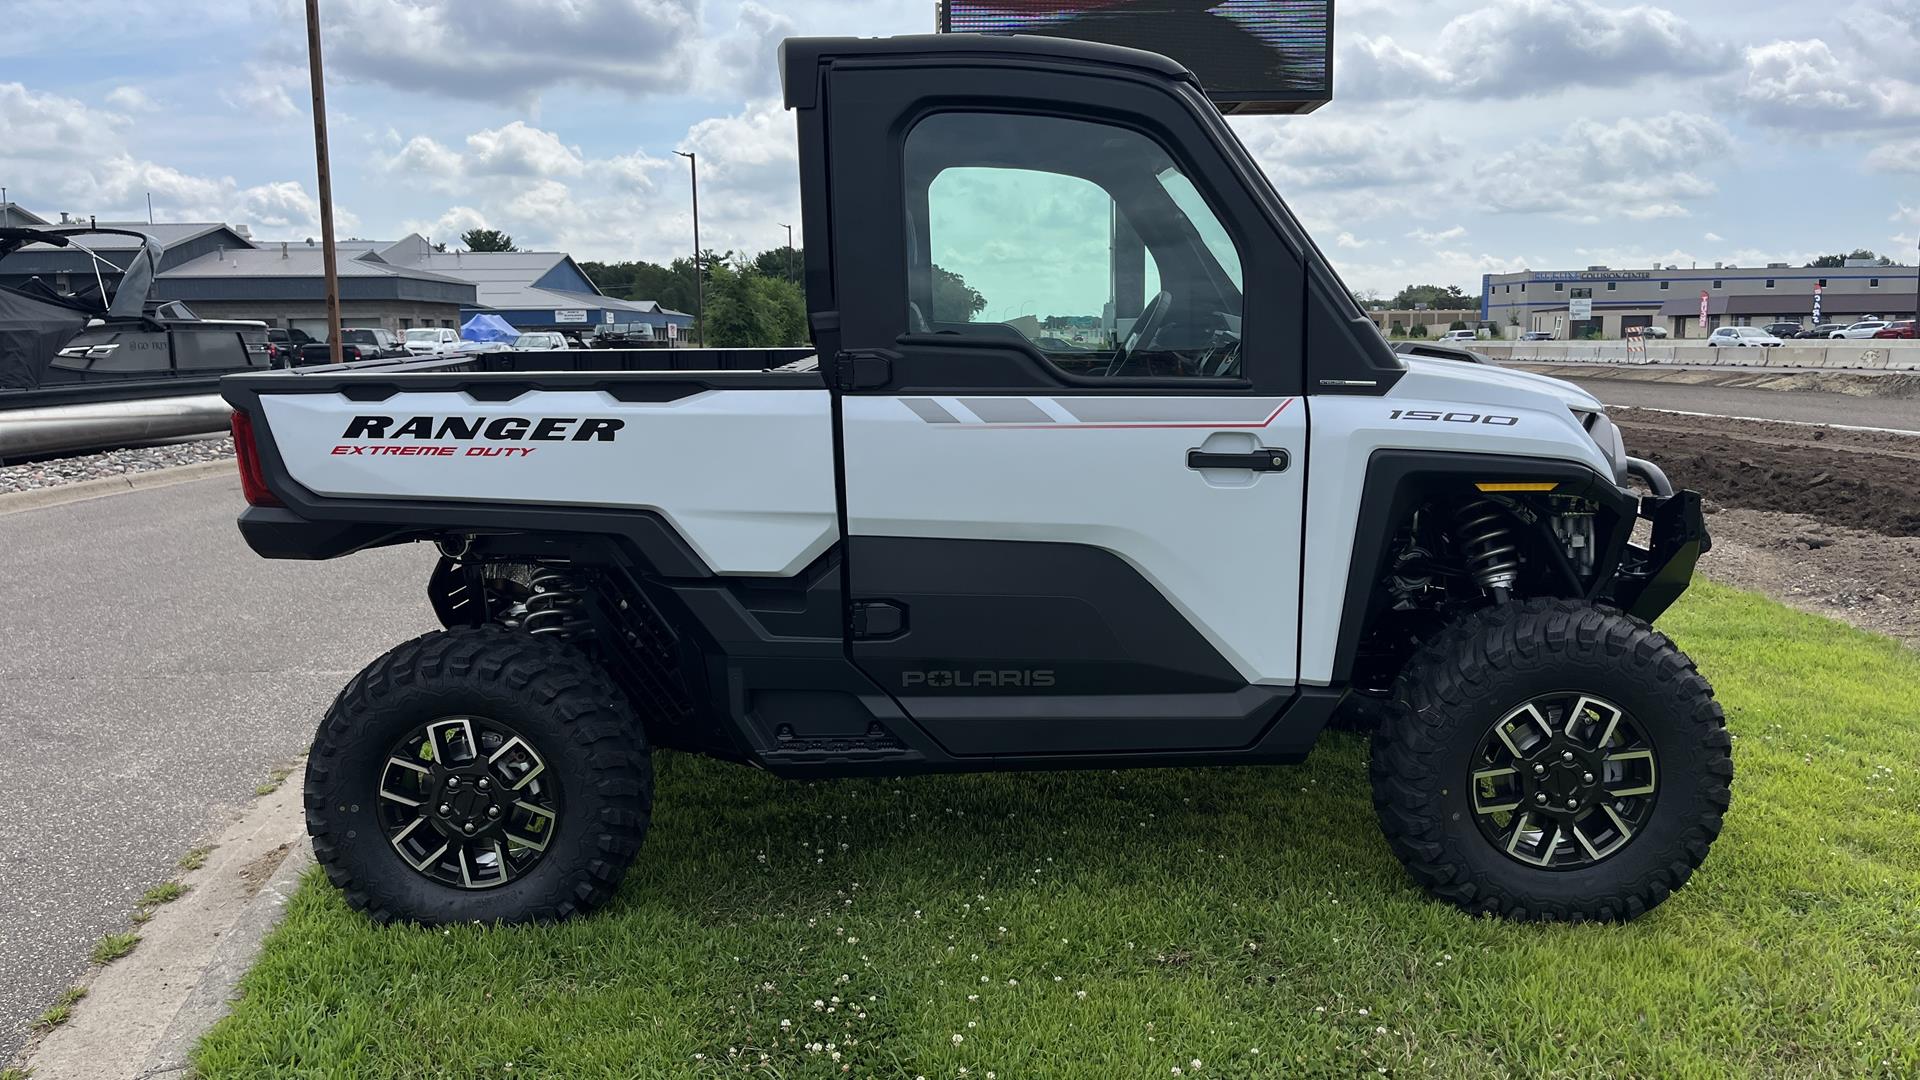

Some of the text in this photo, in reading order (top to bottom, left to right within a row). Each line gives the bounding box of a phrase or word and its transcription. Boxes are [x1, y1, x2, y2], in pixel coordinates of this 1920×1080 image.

[1389, 410, 1519, 426] 1500
[342, 416, 625, 441] RANGER
[330, 445, 536, 457] EXTREME DUTY
[902, 670, 1055, 687] POLARIS
